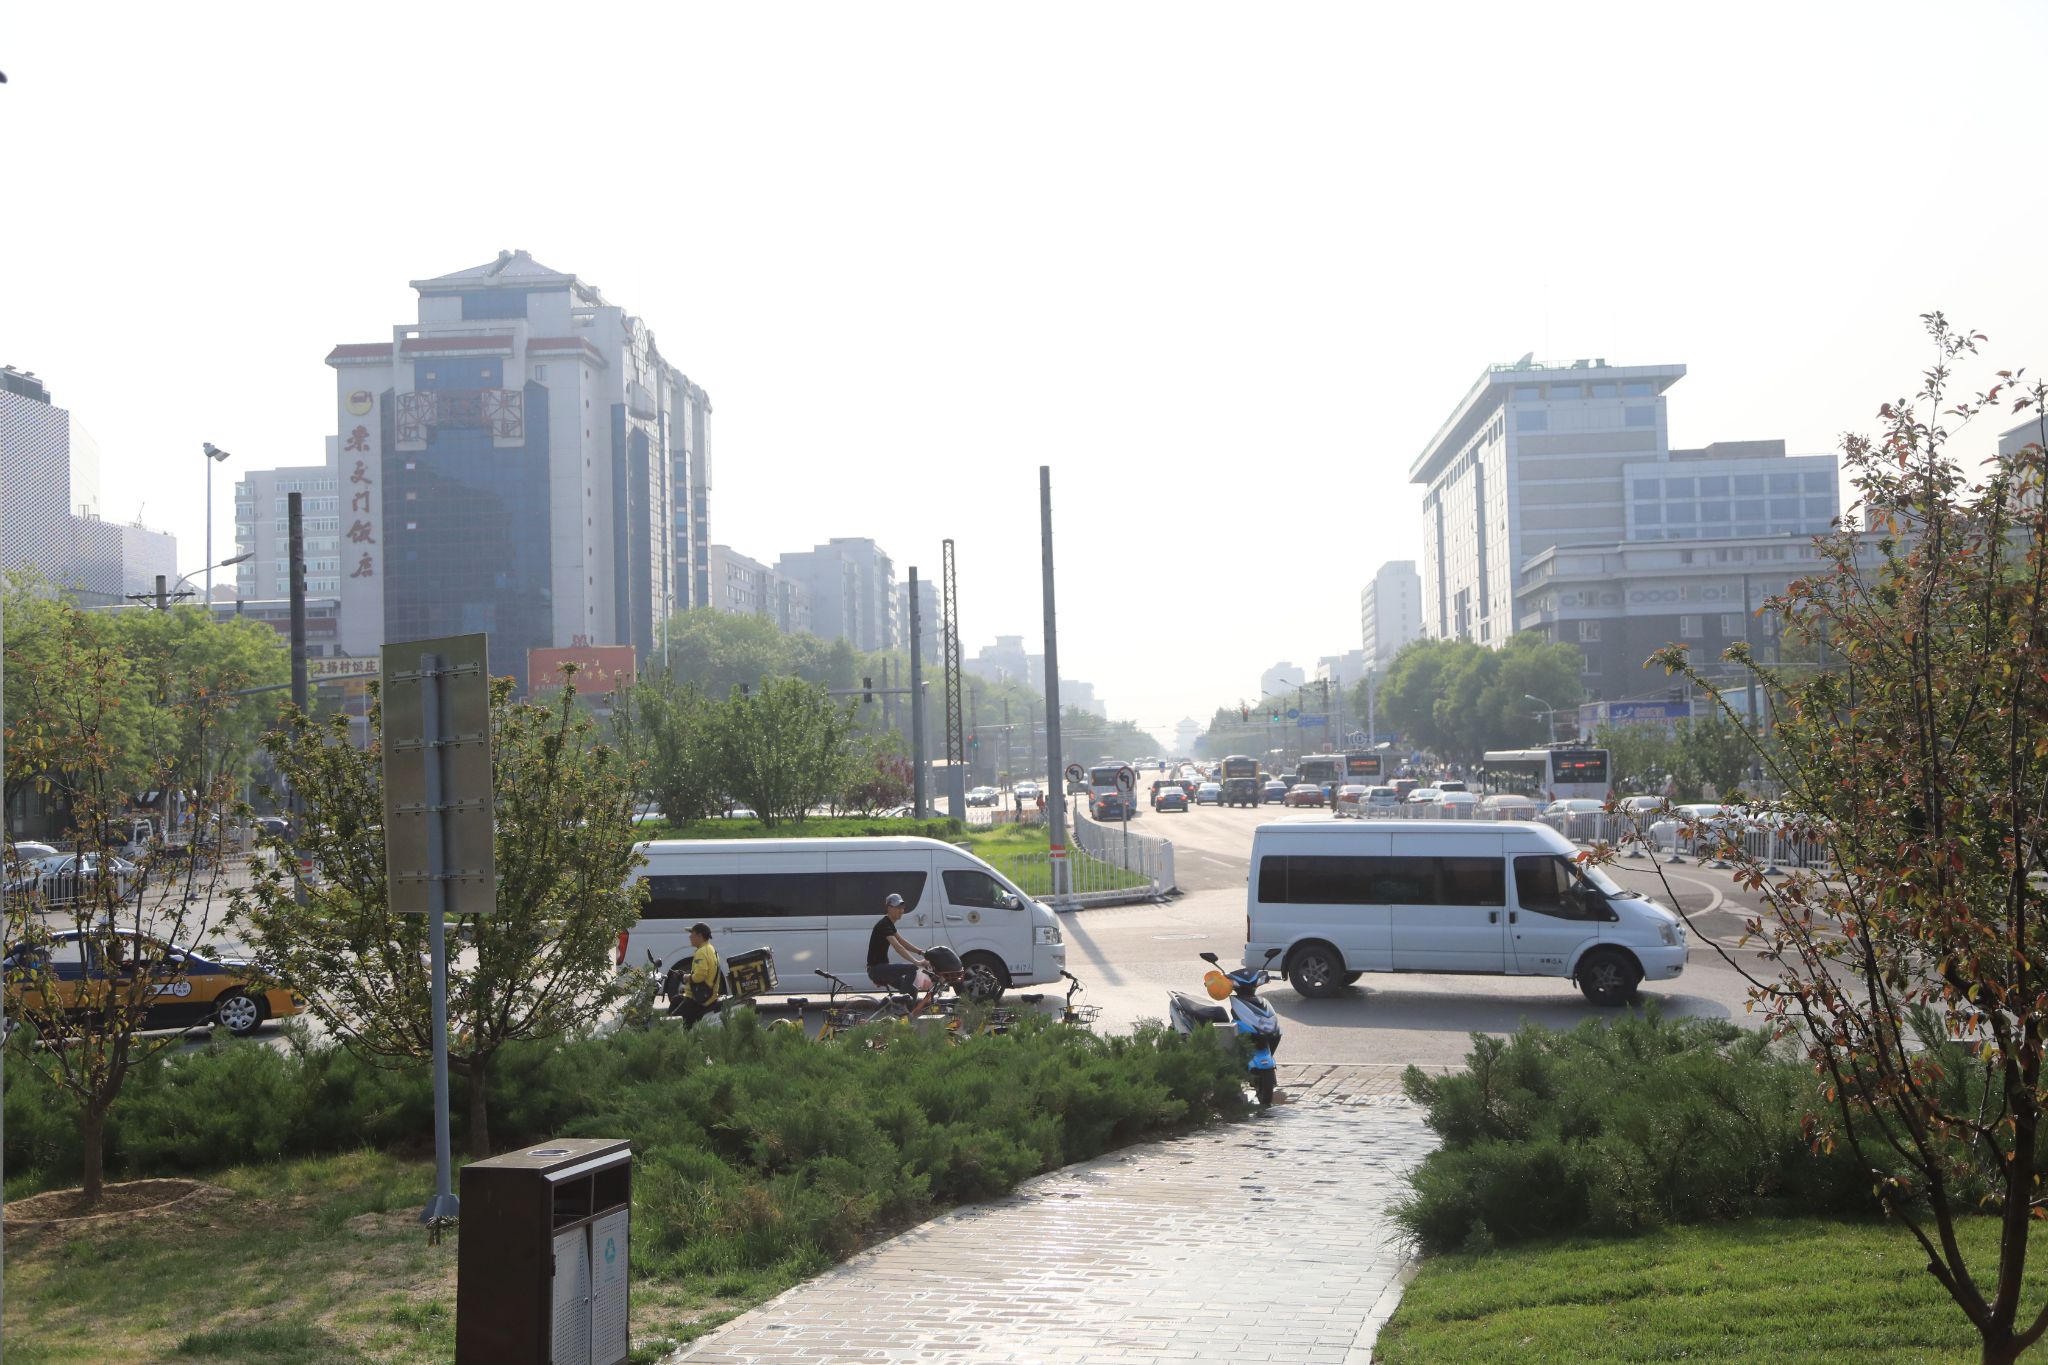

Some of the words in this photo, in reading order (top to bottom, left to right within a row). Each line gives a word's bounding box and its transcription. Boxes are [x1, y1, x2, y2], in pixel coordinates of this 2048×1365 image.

[344, 425, 376, 578] 崇文门饭店
